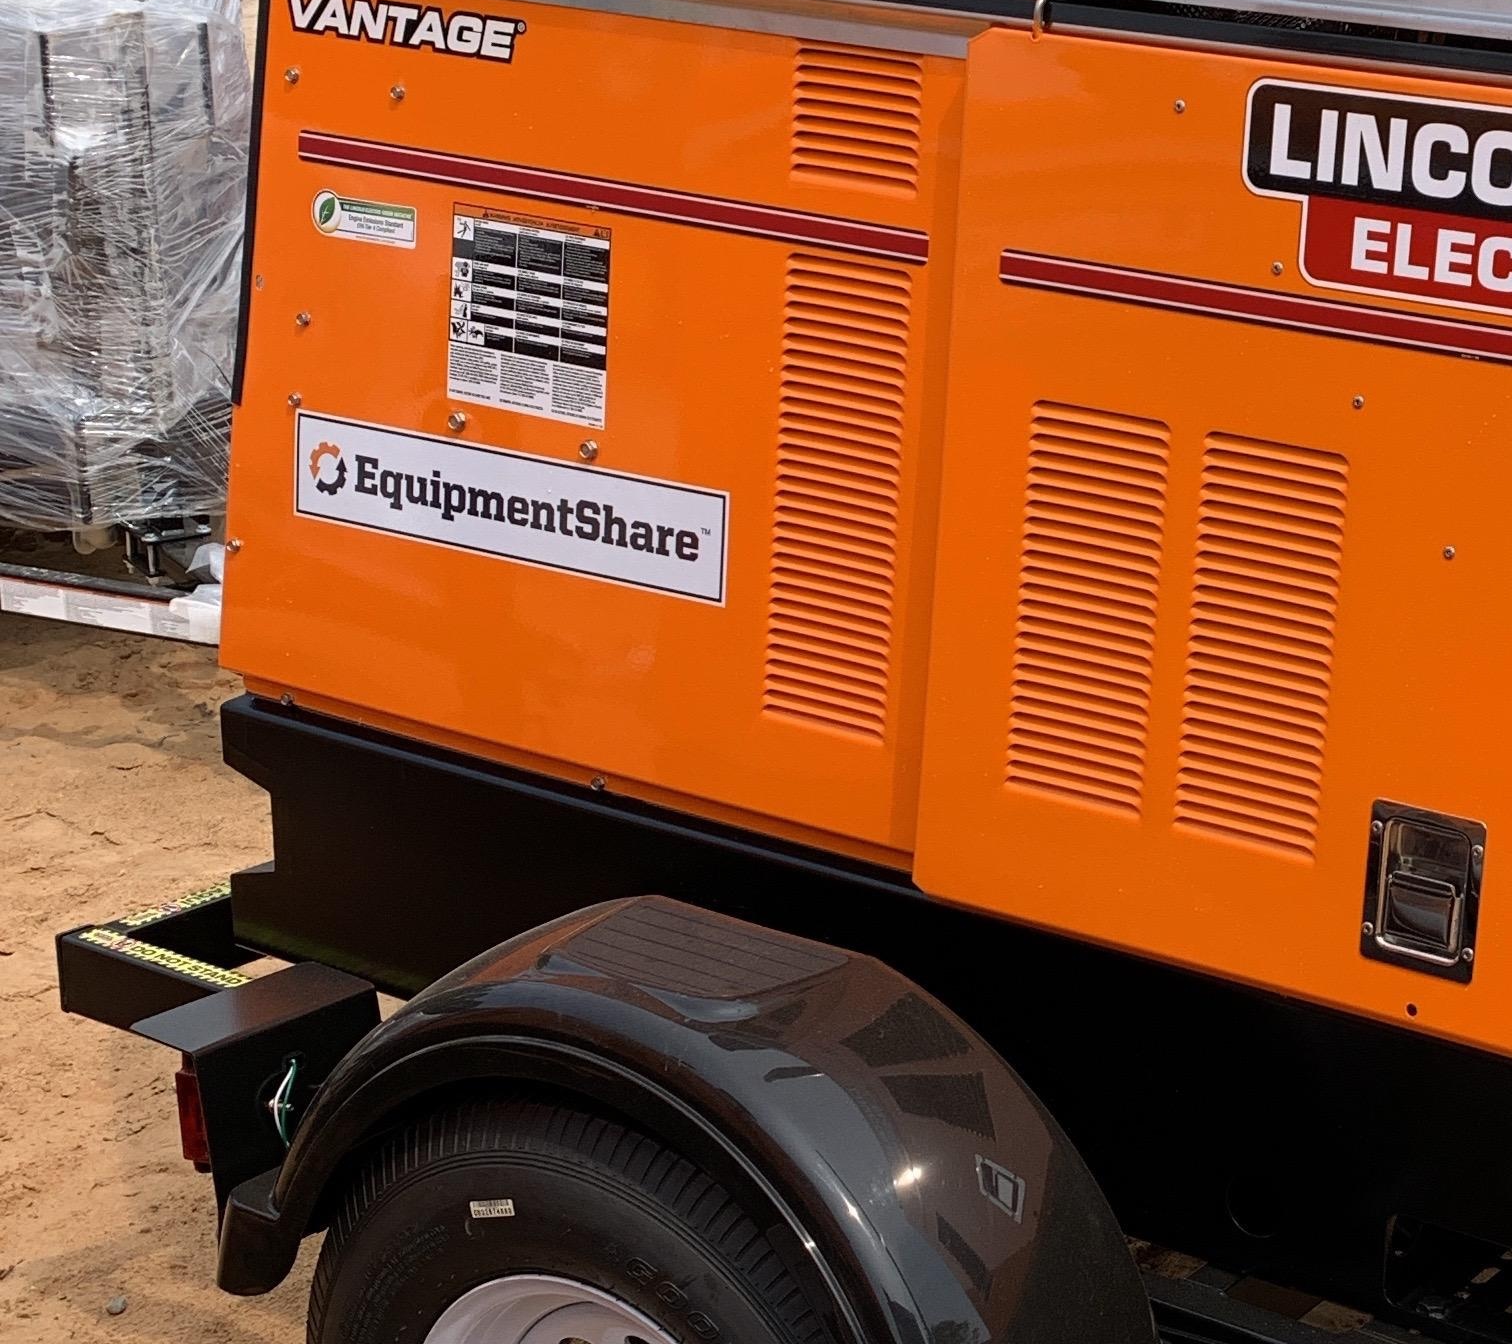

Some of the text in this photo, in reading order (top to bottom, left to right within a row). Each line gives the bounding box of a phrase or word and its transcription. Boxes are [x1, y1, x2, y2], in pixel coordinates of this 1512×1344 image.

[354, 454, 701, 563] EquipmentShare
[131, 945, 243, 985] DO NOT STAND
